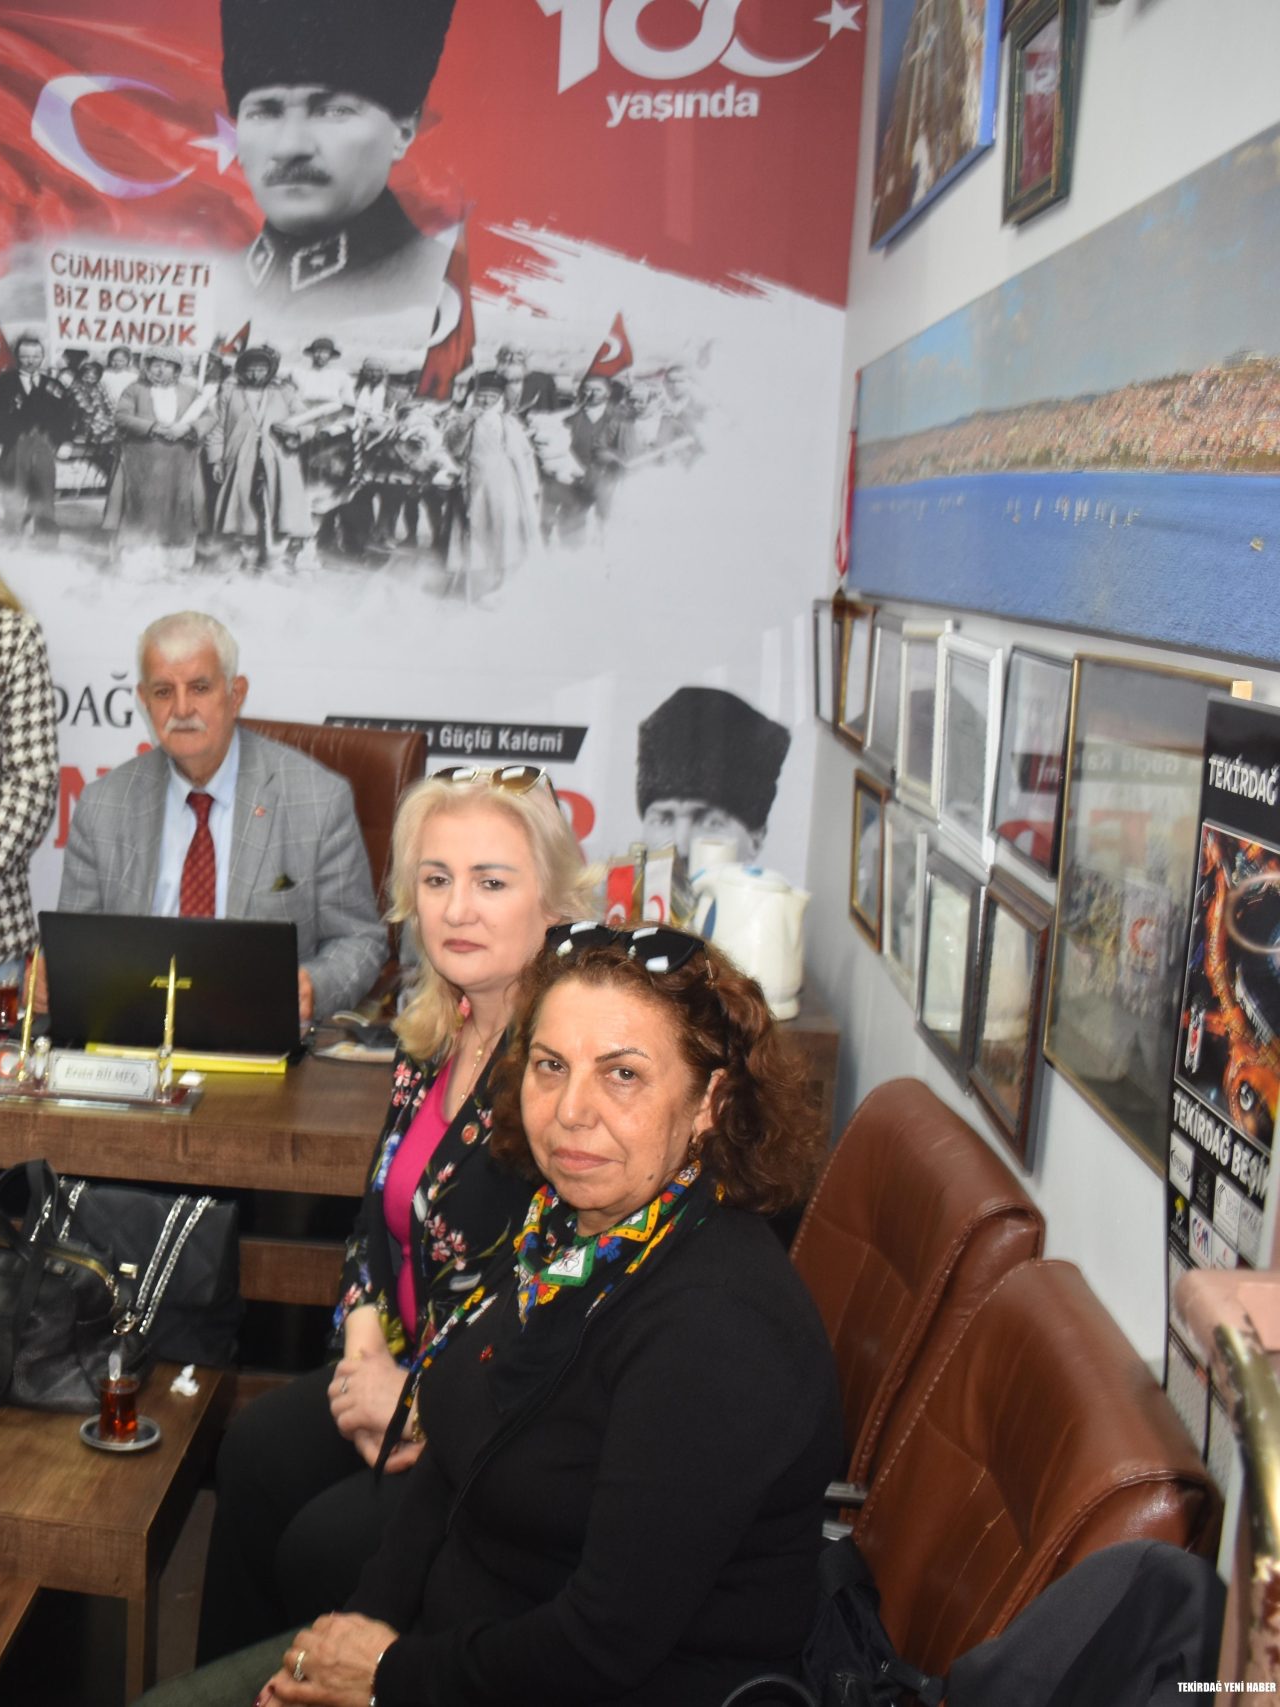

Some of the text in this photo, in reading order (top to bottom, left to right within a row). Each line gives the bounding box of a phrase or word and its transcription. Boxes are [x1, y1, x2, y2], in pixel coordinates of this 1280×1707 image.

[606, 82, 760, 128] yaşında
[51, 252, 210, 287] CÜMHURİYETİ
[53, 283, 196, 317] BİZ BÖYLE
[58, 316, 196, 347] KAZANDIK
[439, 725, 492, 754] Güçlü
[498, 730, 563, 753] Kalemi
[1208, 756, 1278, 806] TEKİRDAĞ
[1173, 1089, 1231, 1167] TEKİRDAĞ
